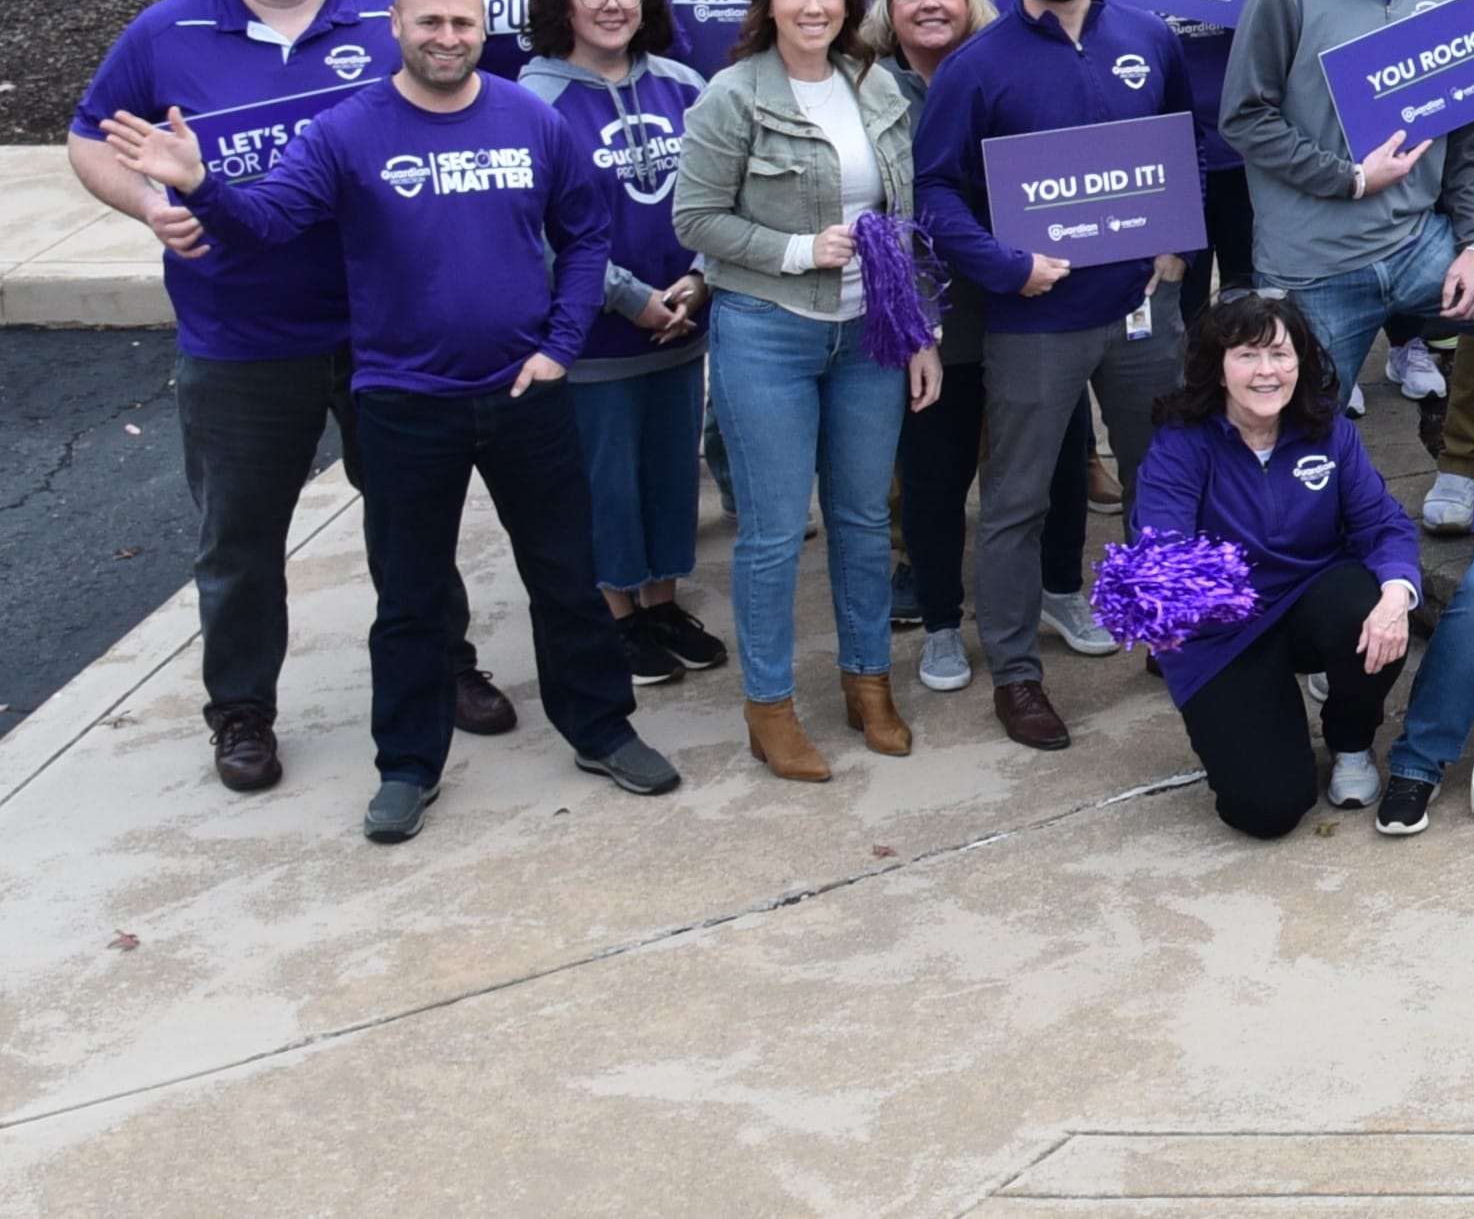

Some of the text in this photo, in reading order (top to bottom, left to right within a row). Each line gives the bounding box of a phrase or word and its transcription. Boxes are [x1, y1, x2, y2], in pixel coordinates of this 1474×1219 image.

[1367, 58, 1414, 92] YOU
[218, 124, 287, 156] LET'S
[381, 167, 431, 180] Guardian
[437, 148, 533, 173] SECONDS
[440, 167, 535, 195] MATTER
[1022, 163, 1166, 203] YOU DID IT!
